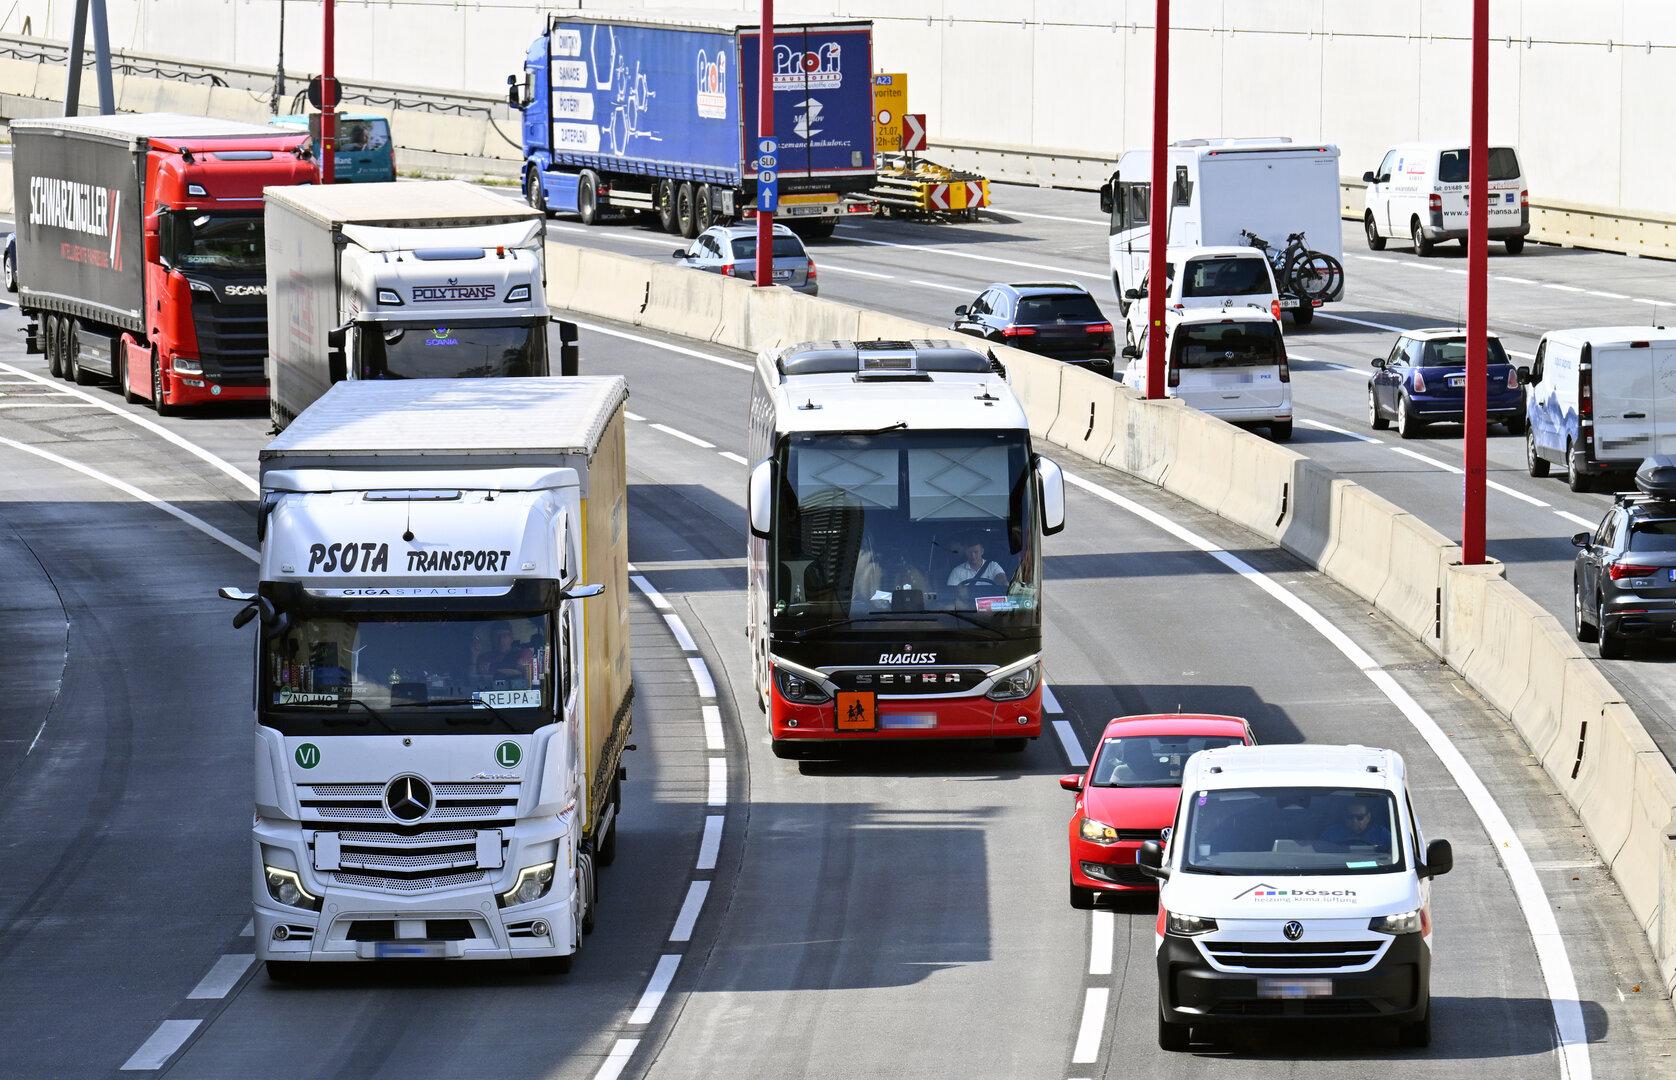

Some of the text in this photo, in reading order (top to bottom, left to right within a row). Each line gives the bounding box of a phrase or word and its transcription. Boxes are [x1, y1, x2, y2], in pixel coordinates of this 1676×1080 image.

[773, 42, 841, 74] Profi
[876, 76, 891, 85] A23
[761, 157, 774, 166] SLO
[764, 172, 771, 181] D
[29, 176, 108, 237] SCHWARZMÜLLER
[412, 286, 496, 300] POLYTRANS
[425, 338, 458, 346] SCANIA
[308, 542, 511, 573] PSOTA TRANSPORT
[879, 653, 937, 664] BLAGUSS
[855, 672, 961, 684] SETRA
[488, 692, 529, 705] REJPA
[299, 748, 317, 765] VI
[502, 745, 515, 764] L
